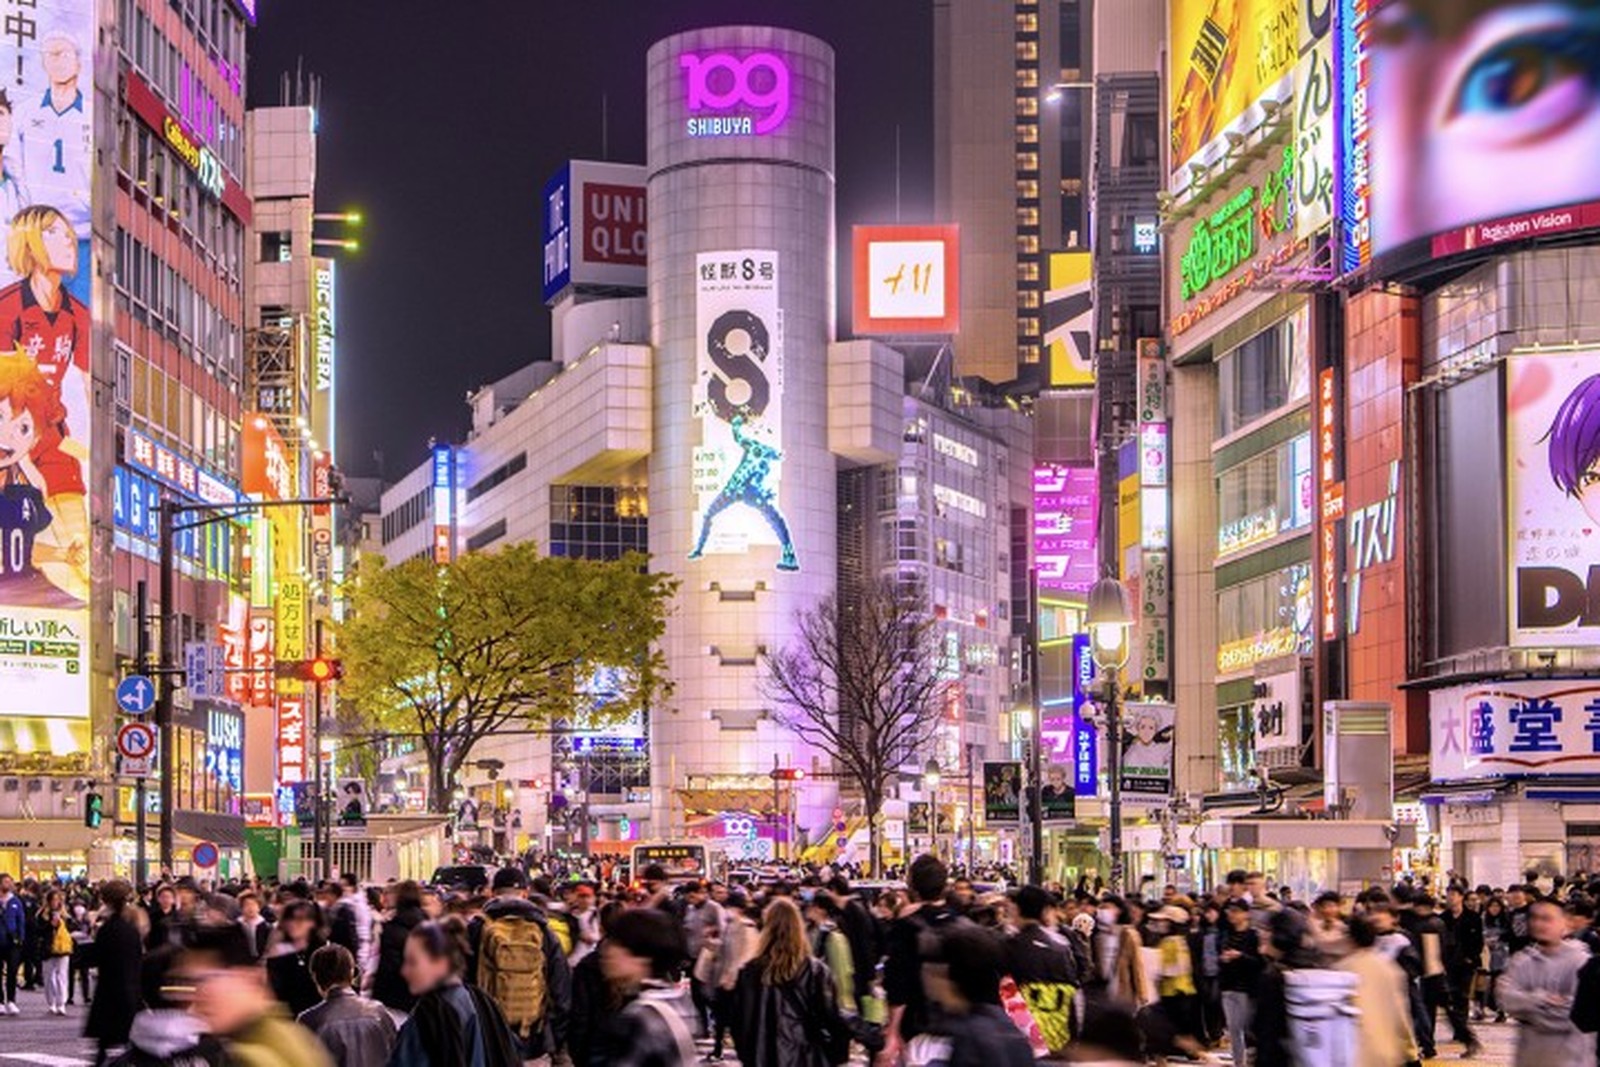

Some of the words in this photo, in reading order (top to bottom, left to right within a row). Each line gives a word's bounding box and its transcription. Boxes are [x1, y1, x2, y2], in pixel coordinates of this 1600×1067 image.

[5, 0, 36, 85] 中！
[680, 53, 790, 134] 109
[687, 117, 751, 136] SHIBUYA
[591, 193, 644, 223] UNI
[1532, 212, 1573, 230] Vision
[591, 226, 647, 258] QLO
[208, 710, 240, 750] LUSH
